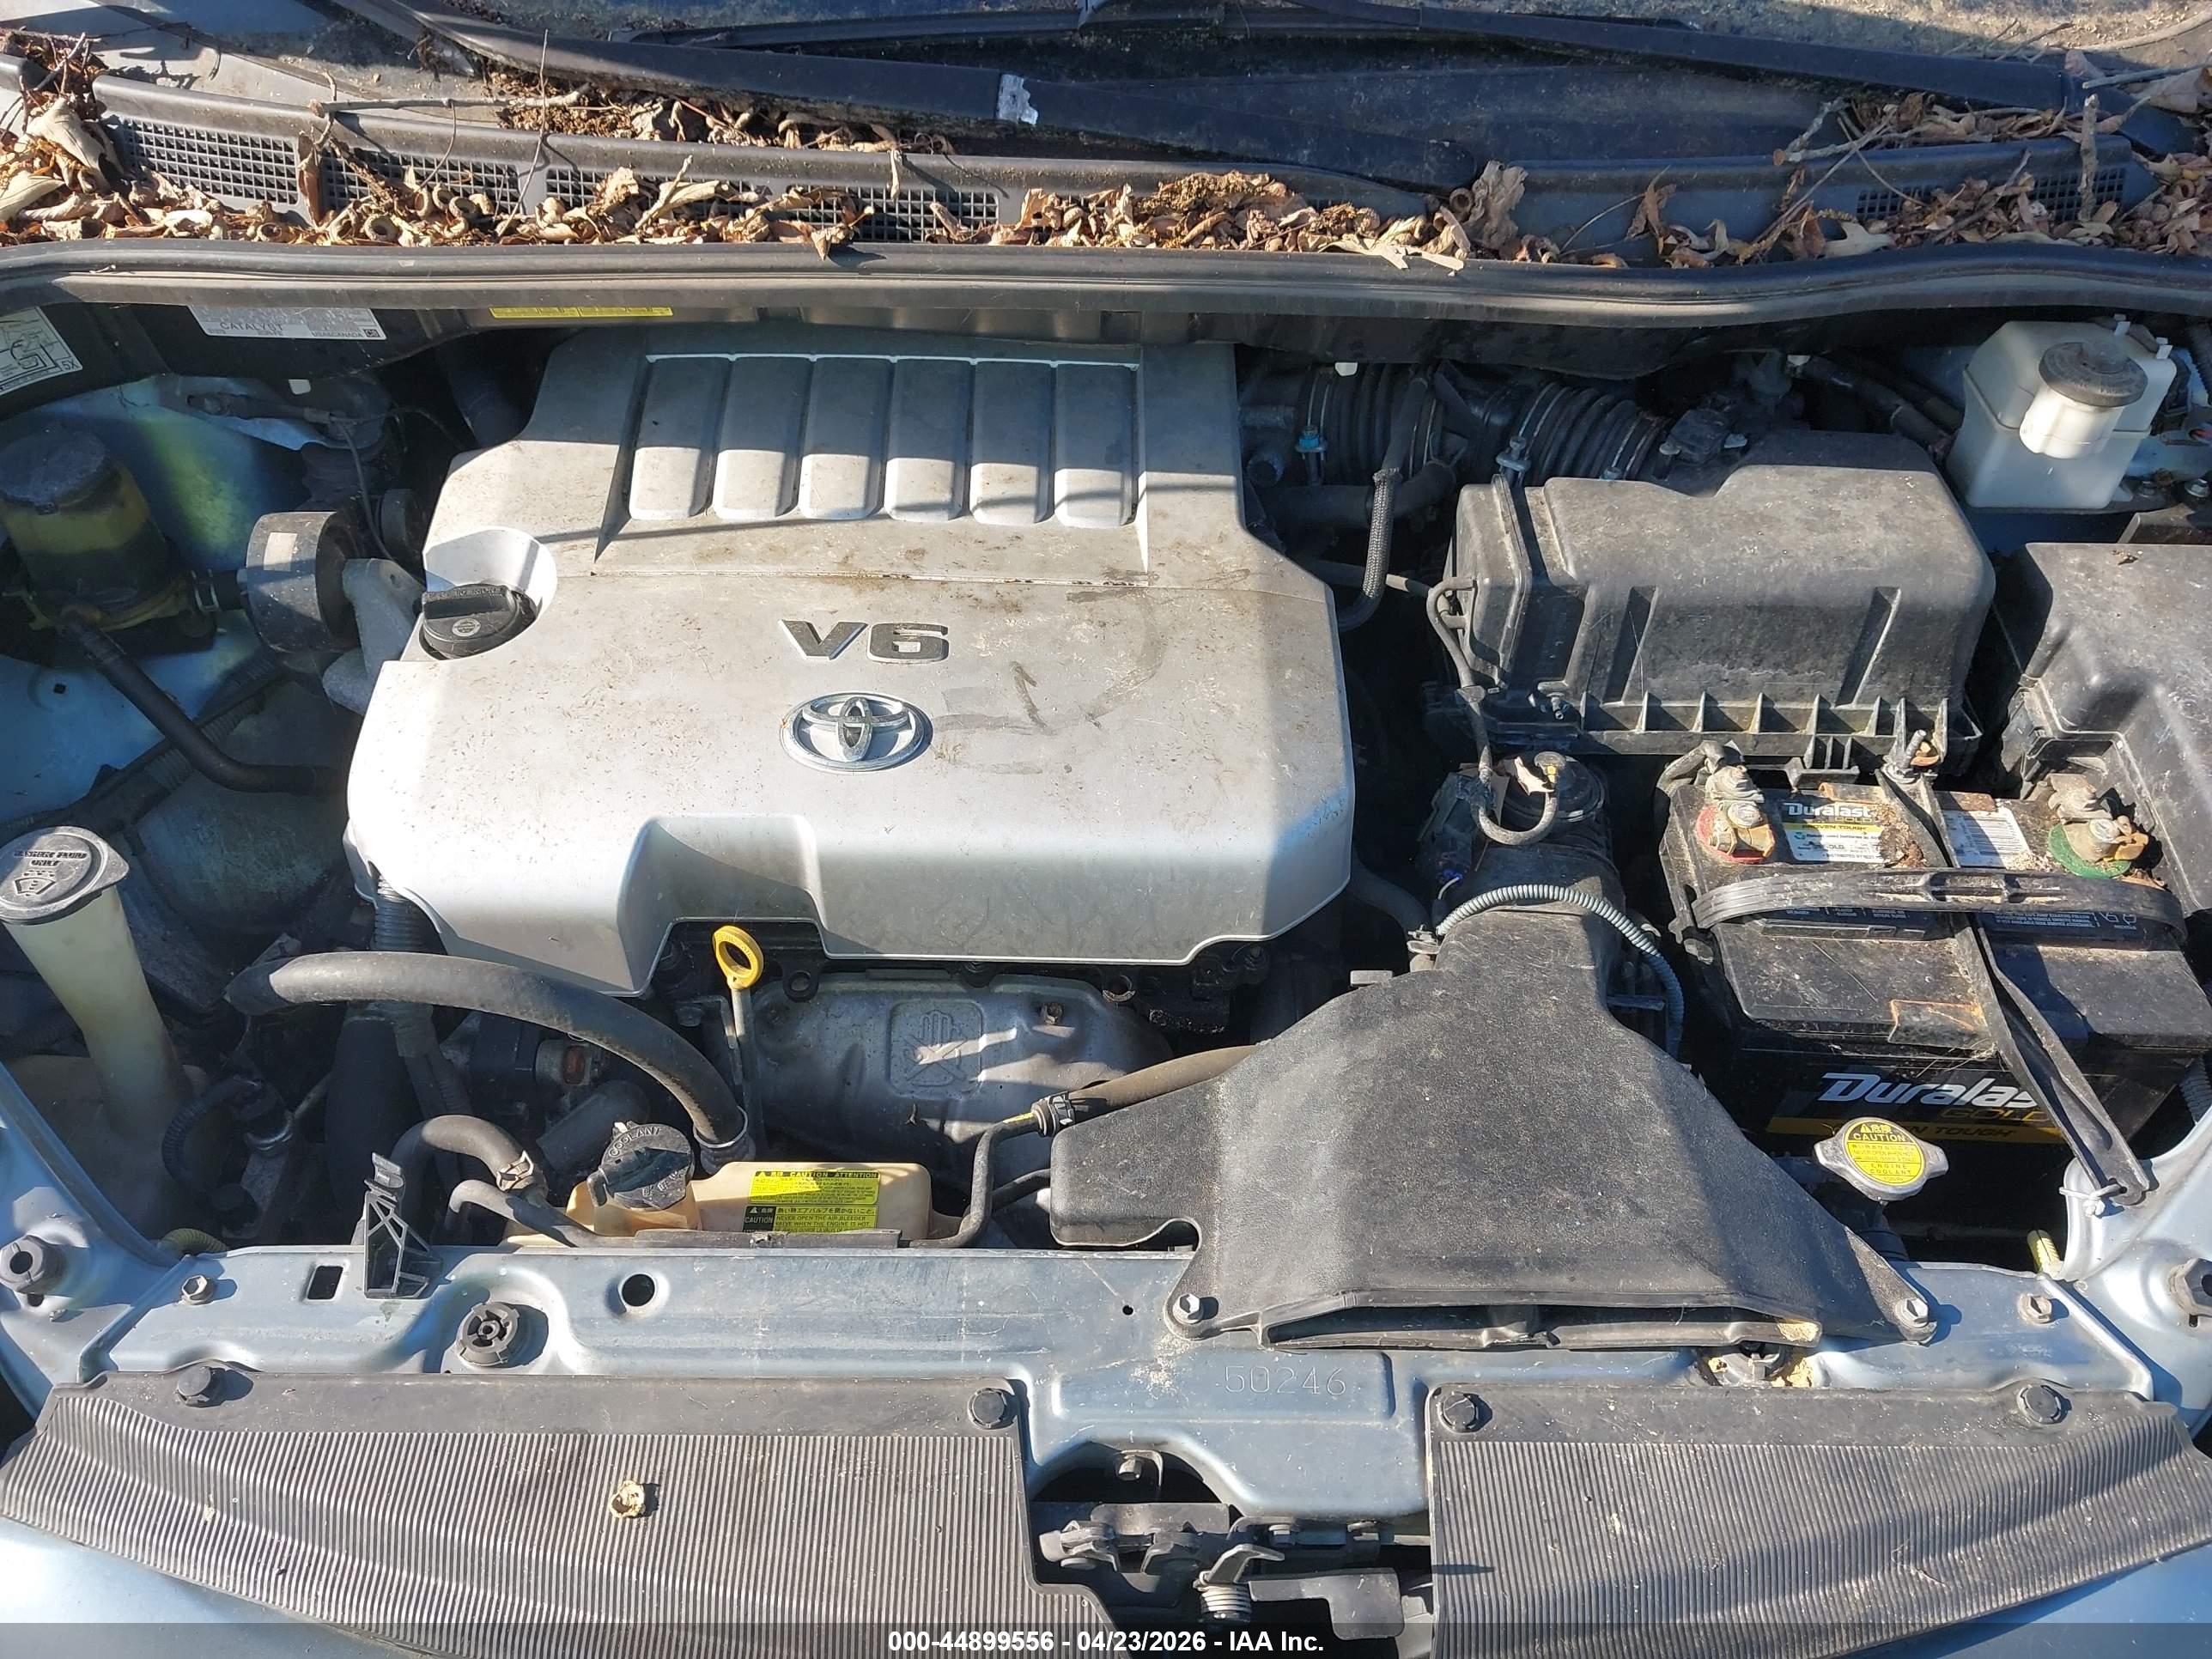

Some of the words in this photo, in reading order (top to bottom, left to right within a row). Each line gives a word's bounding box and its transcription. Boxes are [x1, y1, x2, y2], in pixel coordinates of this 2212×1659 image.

[220, 322, 283, 331] CATALYST
[61, 359, 78, 370] 5X
[778, 619, 950, 664] V6
[1783, 802, 1872, 817] Duralast
[1819, 1073, 2038, 1109] Duralas
[1940, 1108, 2051, 1121] GOLD
[609, 1126, 662, 1158] COOLANT
[1854, 1133, 1906, 1142] CAUTION
[1225, 1365, 1346, 1395] 50246
